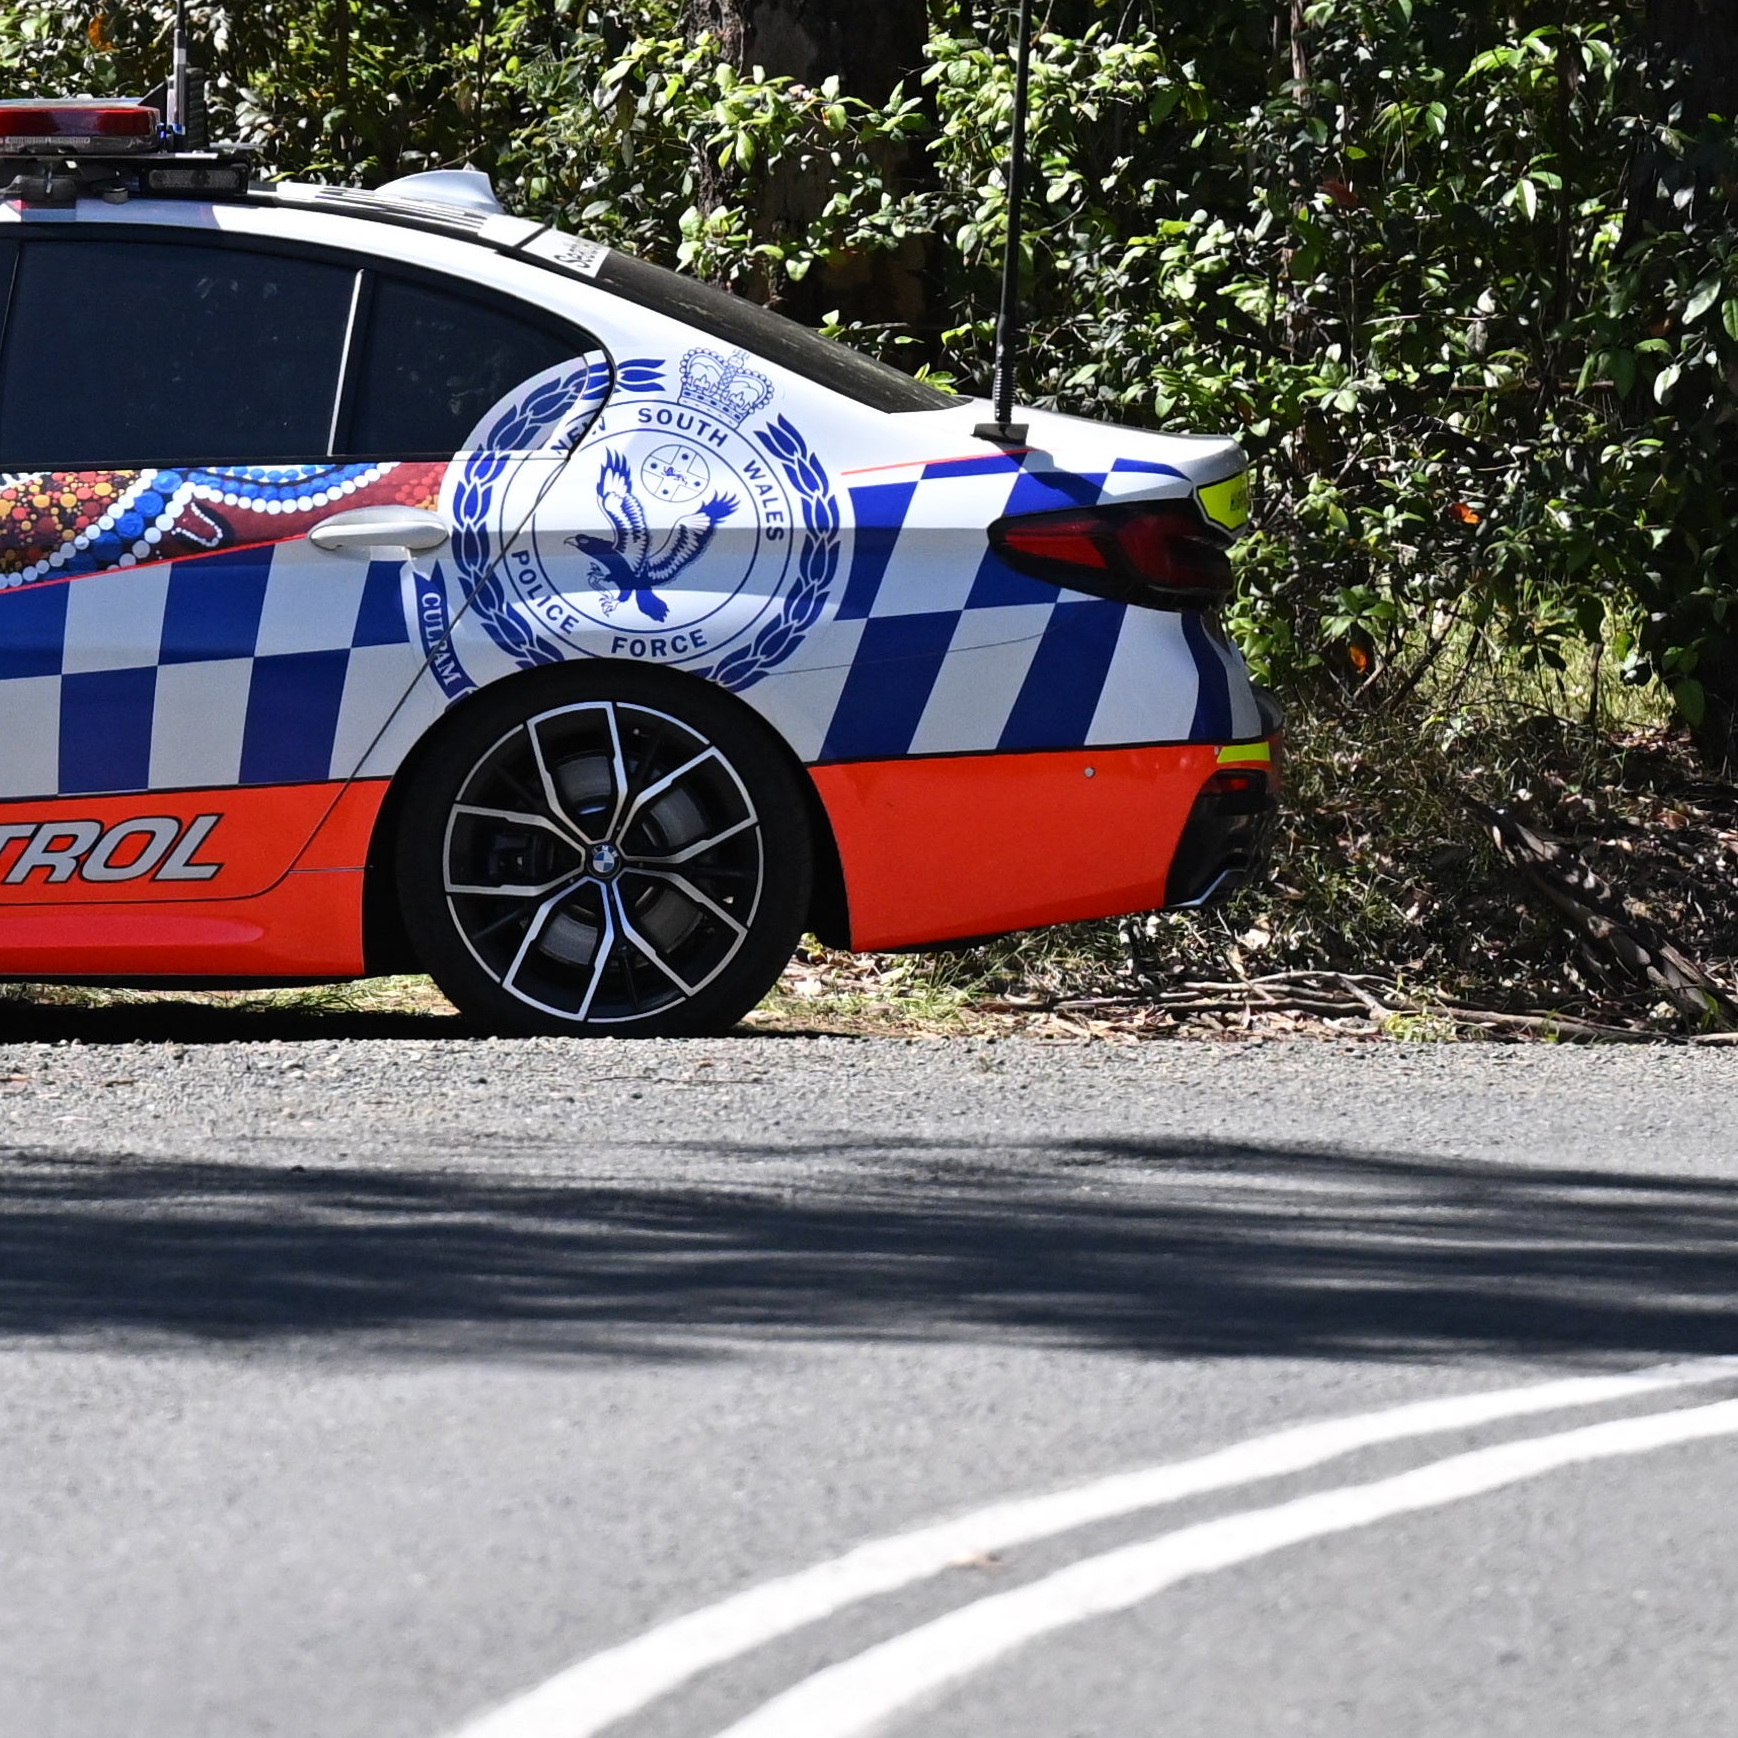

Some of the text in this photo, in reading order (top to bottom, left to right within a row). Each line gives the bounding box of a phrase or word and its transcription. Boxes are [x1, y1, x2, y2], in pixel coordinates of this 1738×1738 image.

[637, 407, 729, 448] SOUTH
[743, 459, 785, 542] WALES
[421, 592, 462, 686] CULPAM
[511, 550, 708, 657] POLICE FORCE
